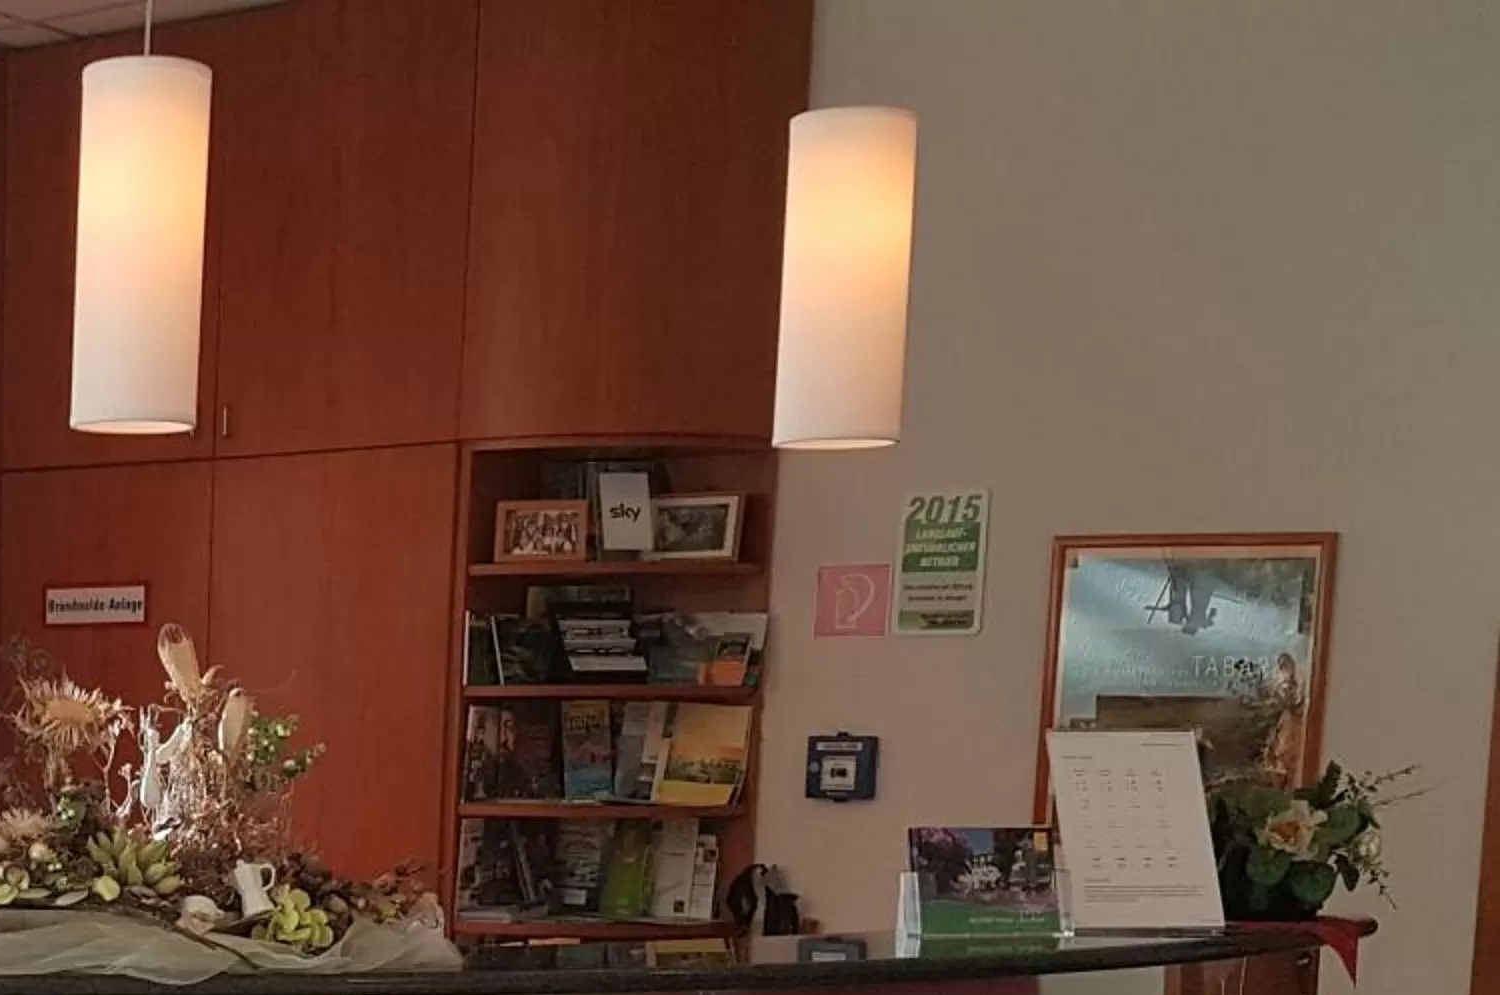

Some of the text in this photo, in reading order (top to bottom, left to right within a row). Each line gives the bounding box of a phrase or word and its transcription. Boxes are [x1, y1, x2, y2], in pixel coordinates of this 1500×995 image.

[609, 502, 641, 523] sky
[909, 495, 982, 523] 2015
[109, 597, 143, 613] Anlage
